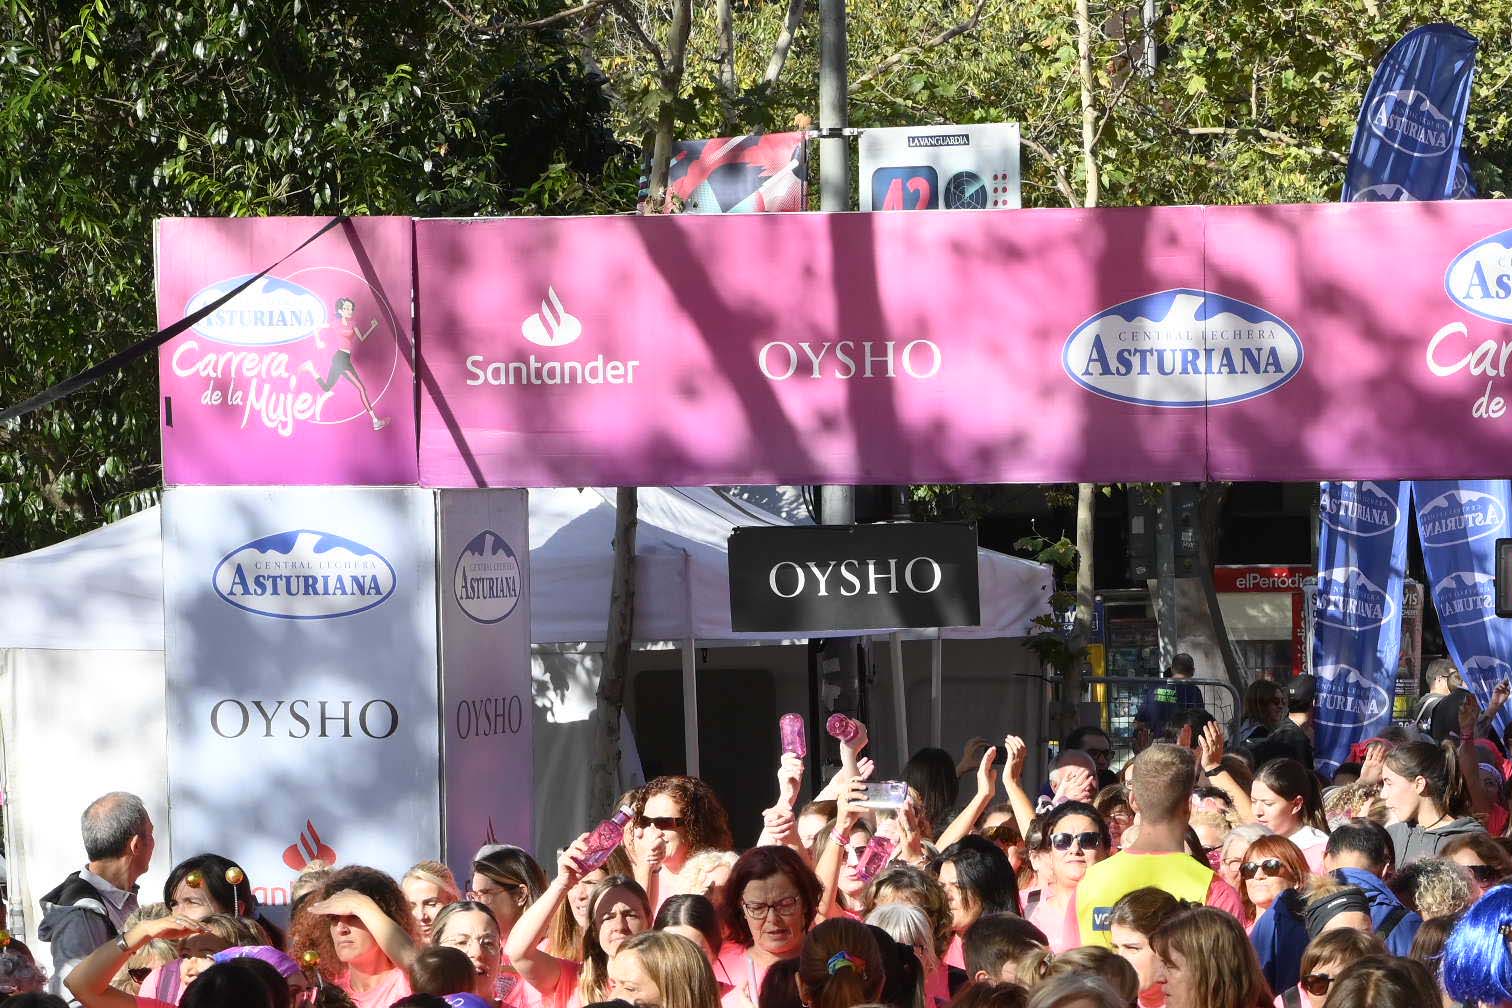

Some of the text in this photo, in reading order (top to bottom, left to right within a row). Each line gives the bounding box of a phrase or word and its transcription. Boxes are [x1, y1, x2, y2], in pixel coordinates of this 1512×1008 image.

[1374, 102, 1447, 148] ASTURIANA
[1117, 328, 1277, 342] CENTRAL LECHERA
[171, 340, 289, 378] Carrera
[466, 353, 640, 386] Santander
[758, 339, 942, 381] OYSHO
[1081, 333, 1284, 377] ASTURIANA
[200, 376, 336, 437] de la Mujer
[1471, 382, 1507, 418] de
[227, 562, 384, 597] ASTURIANA
[254, 561, 313, 570] CENTRAL
[459, 566, 518, 600] ASTURIANA
[768, 556, 942, 599] OYSHO
[210, 699, 400, 739] OYSHO
[456, 695, 523, 740] OYSHO
